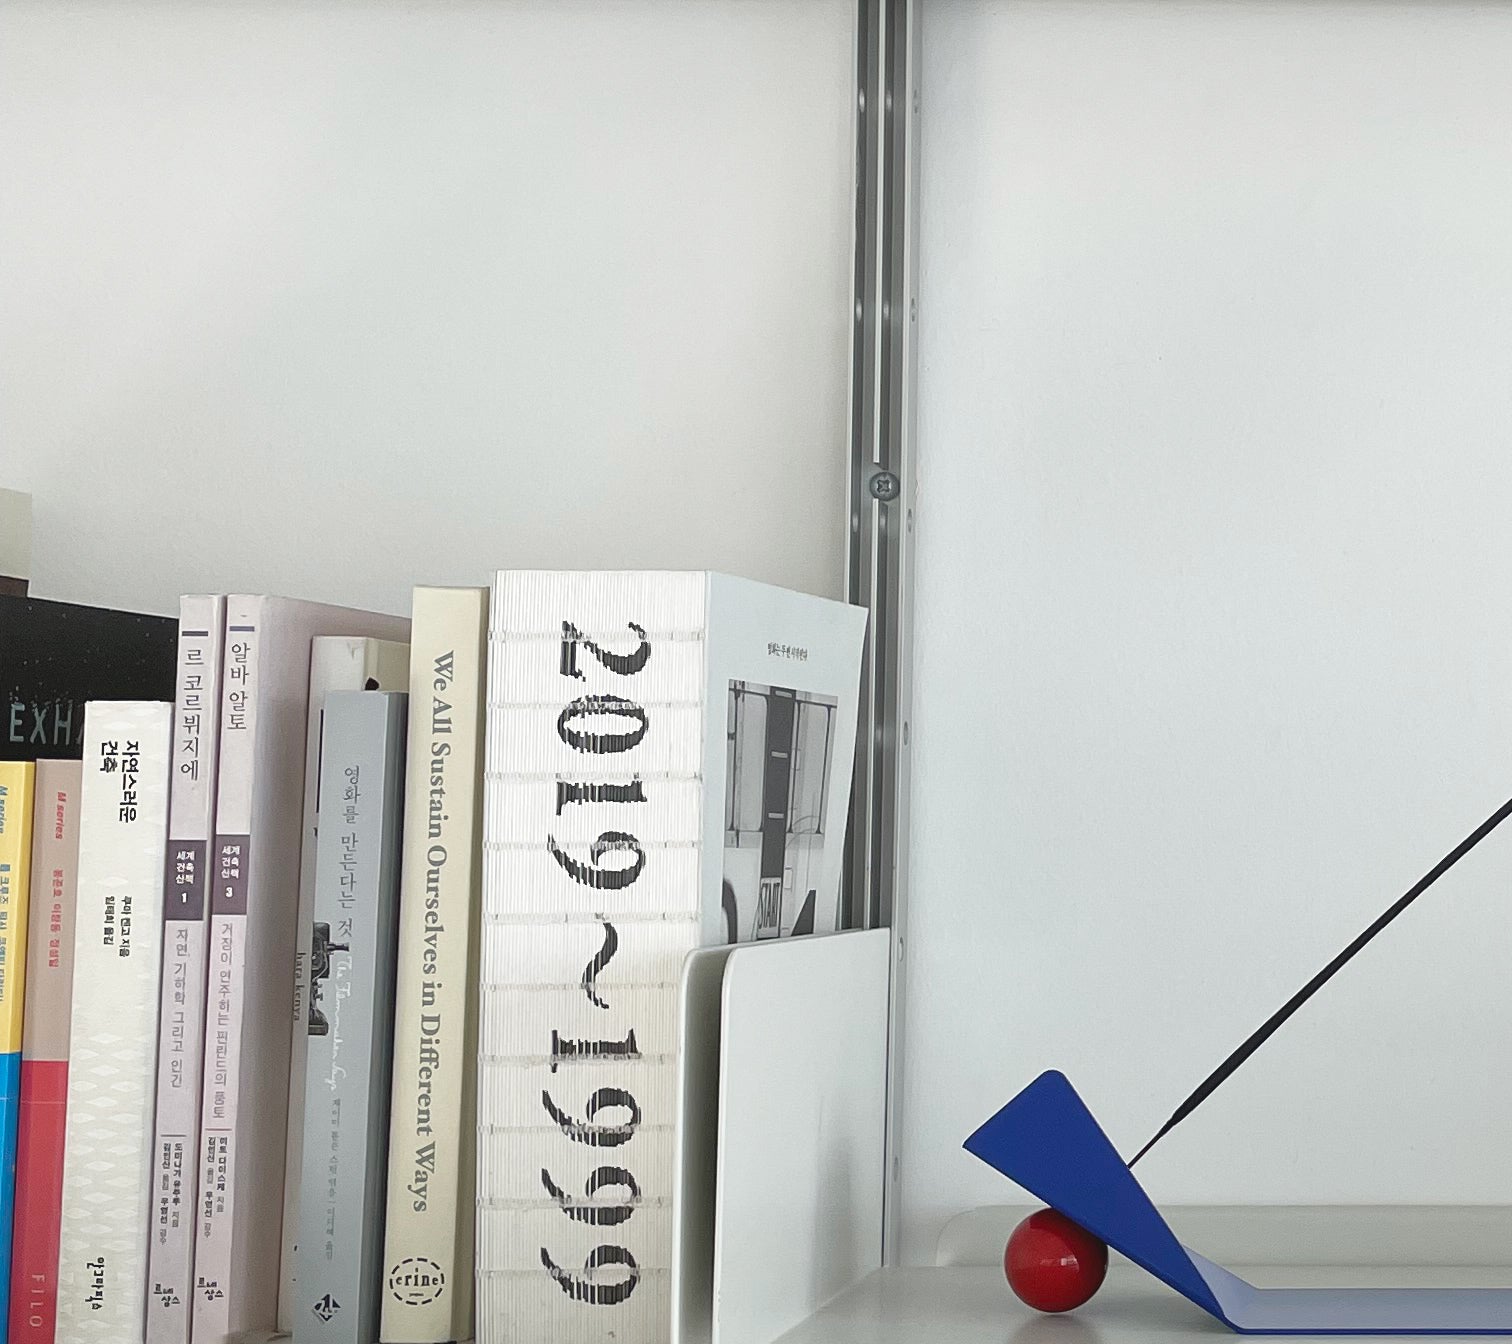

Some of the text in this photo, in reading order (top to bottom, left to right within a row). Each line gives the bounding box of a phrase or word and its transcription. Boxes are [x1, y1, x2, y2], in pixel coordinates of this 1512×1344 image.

[99, 740, 119, 773] 건축
[119, 740, 140, 823] 자연스러운
[407, 650, 455, 1211] We All Sustain Ourselves in Different Ways
[29, 1274, 45, 1327] FILO
